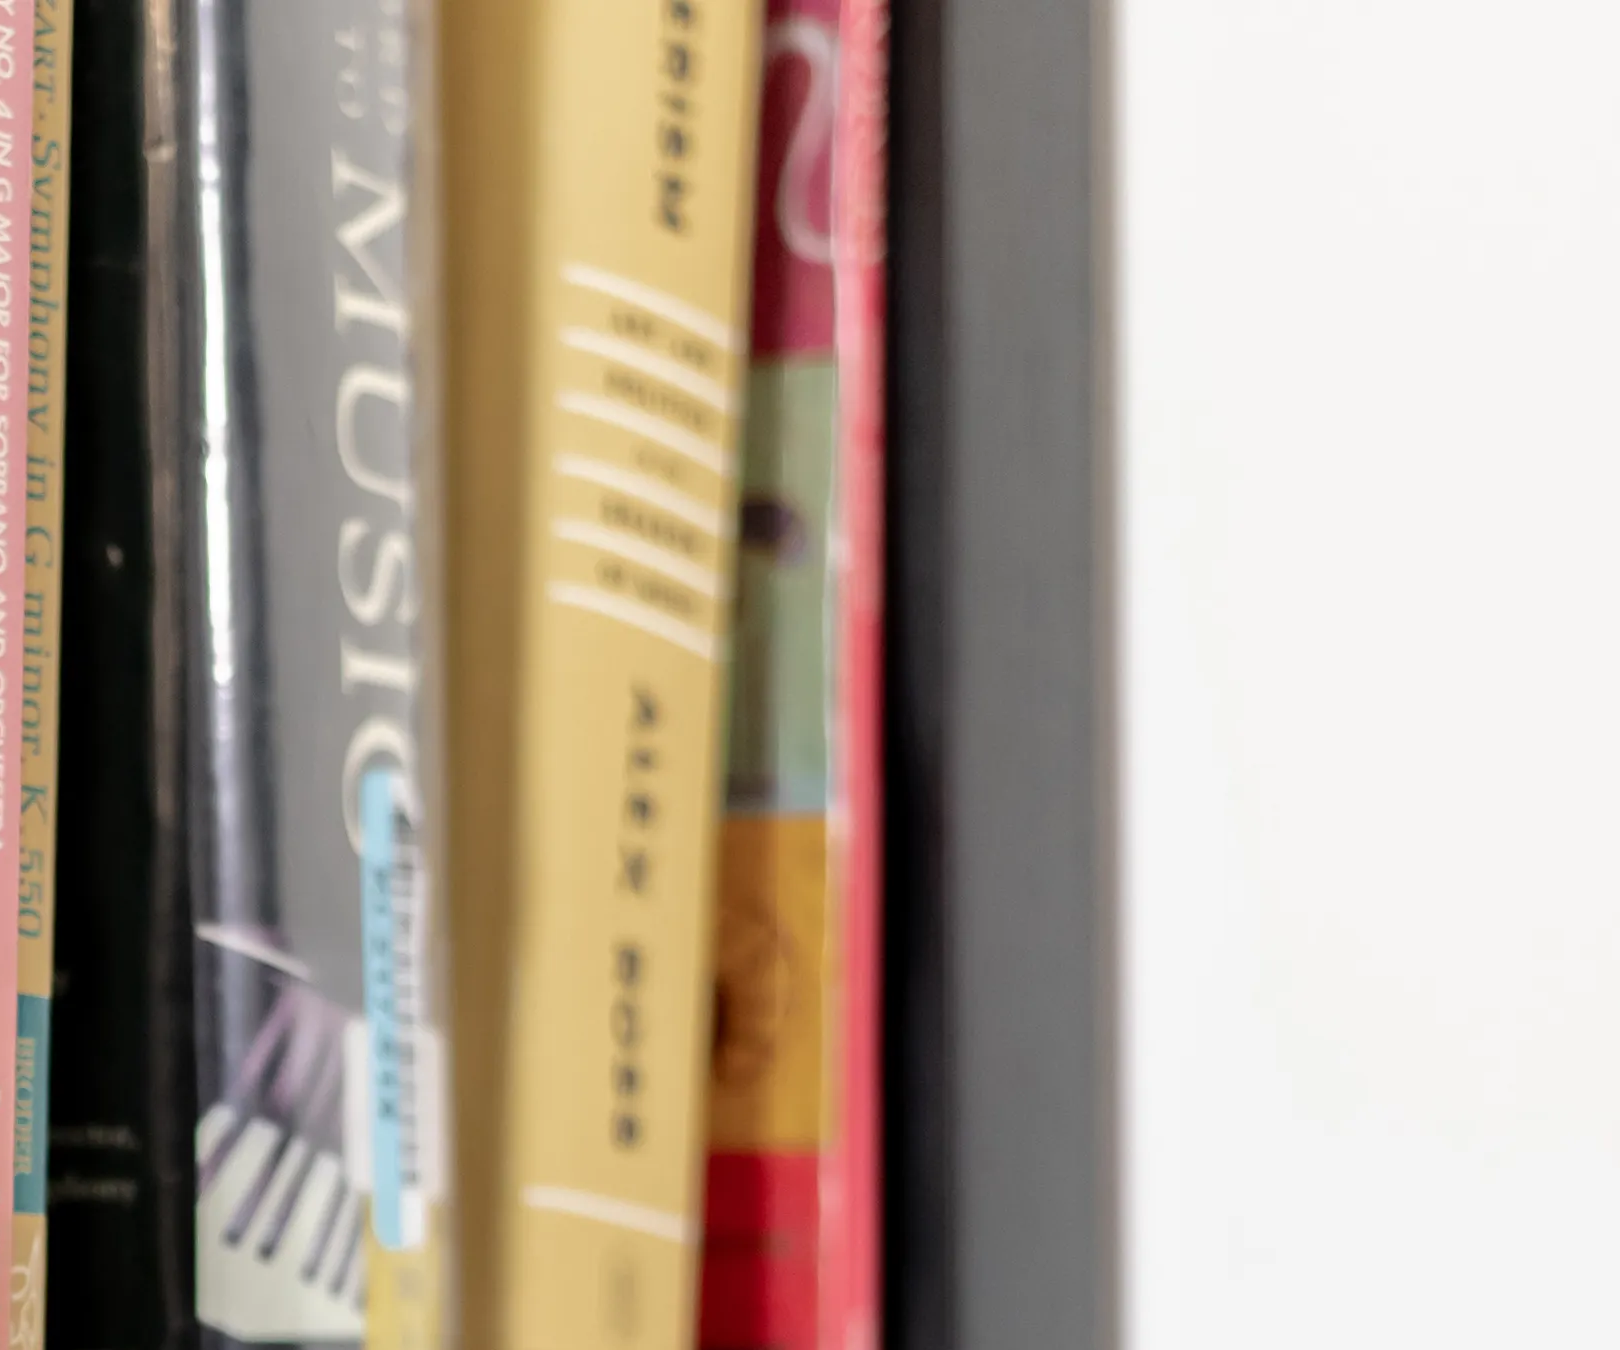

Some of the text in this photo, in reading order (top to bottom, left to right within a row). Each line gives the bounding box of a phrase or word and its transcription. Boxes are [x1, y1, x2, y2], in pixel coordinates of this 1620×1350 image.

[26, 452, 57, 502] in
[332, 145, 422, 862] MUSIC
[25, 525, 56, 569] G
